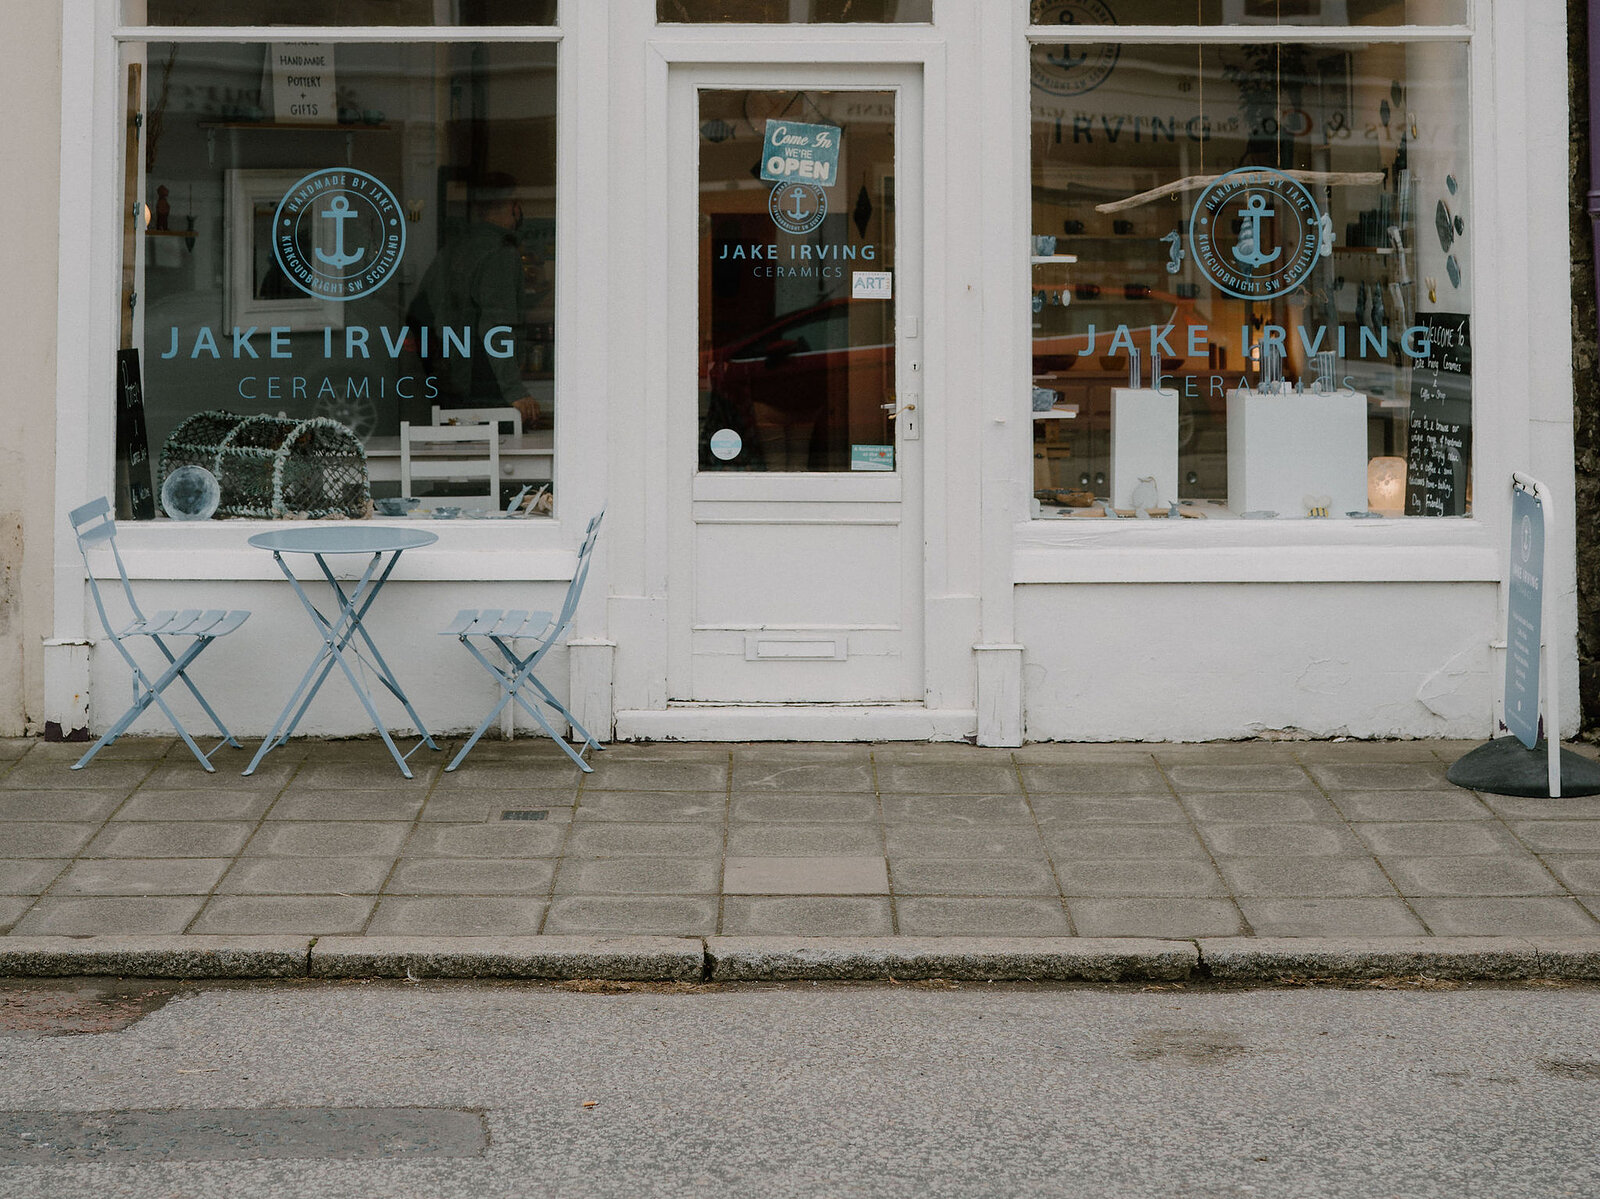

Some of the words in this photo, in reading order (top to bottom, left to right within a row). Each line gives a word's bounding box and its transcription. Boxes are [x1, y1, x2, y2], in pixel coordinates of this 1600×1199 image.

[280, 55, 326, 66] HANDMADE
[287, 75, 321, 88] POTTERY
[290, 104, 319, 116] GIFTS
[771, 126, 809, 148] Come
[811, 131, 833, 149] In
[1054, 115, 1212, 145] IRVING
[785, 148, 813, 159] WE'RE
[767, 156, 829, 181] OPEN
[288, 175, 347, 213] HANDMADE
[352, 177, 368, 190] BY
[369, 187, 394, 213] JAKE
[1205, 174, 1262, 211] HANDMADE
[1268, 175, 1285, 189] BY
[1285, 186, 1310, 212] JAKE
[281, 234, 344, 293] KIRKCUDBRIGHT
[348, 279, 364, 293] SW
[366, 234, 399, 284] SCOTLAND
[719, 244, 778, 260] JAKE
[791, 244, 875, 260] IRVING
[1198, 233, 1261, 293] KIRKCUDBRIGHT
[1265, 278, 1280, 292] SW
[1283, 233, 1316, 283] SCOTLAND
[753, 266, 843, 278] CERAMICS
[854, 277, 886, 289] ART
[160, 325, 293, 360] JAKE
[324, 325, 515, 360] IRVING
[1077, 323, 1210, 358] JAKE
[1241, 324, 1432, 359] IRVING
[237, 375, 439, 399] CERAMICS
[1155, 374, 1356, 398] CERAMICS
